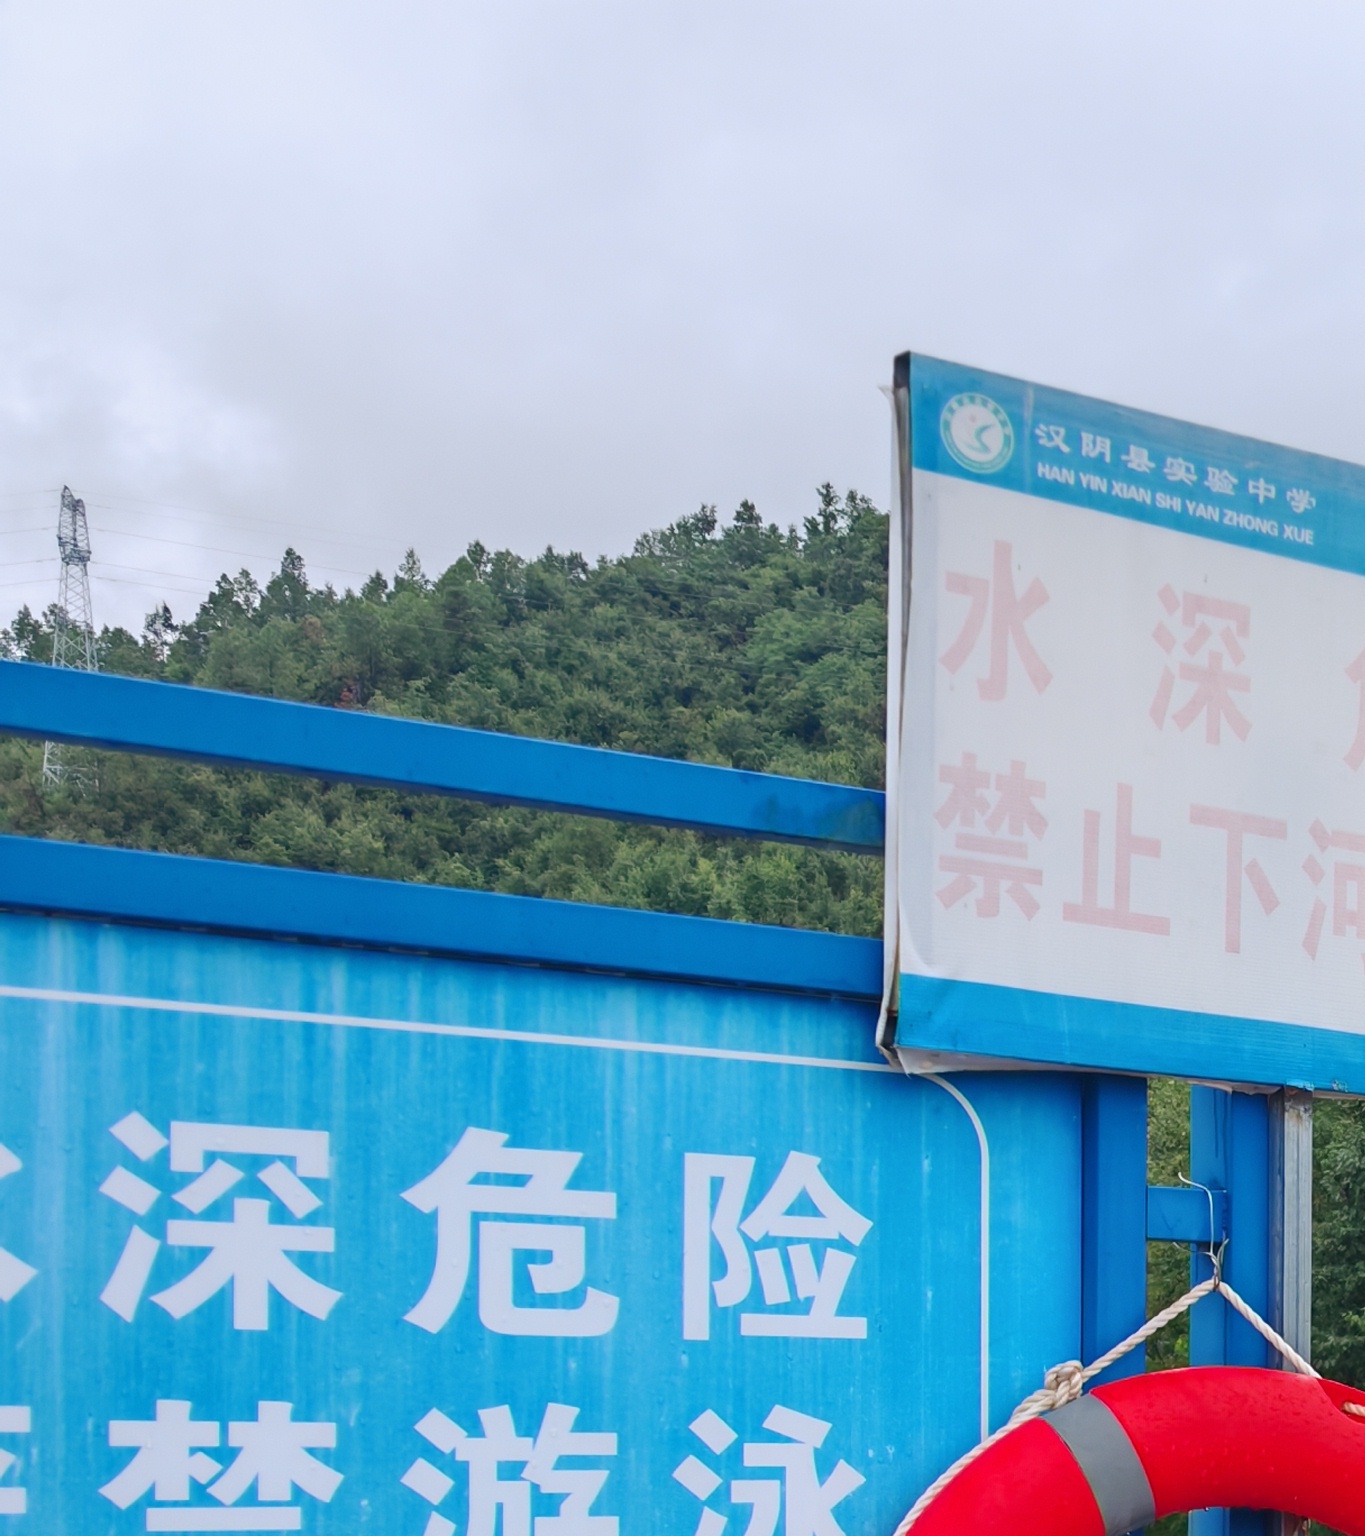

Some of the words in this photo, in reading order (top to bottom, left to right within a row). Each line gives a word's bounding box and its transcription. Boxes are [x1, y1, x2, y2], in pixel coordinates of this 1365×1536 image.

[1034, 423, 1316, 514] 汉阴县实验中学
[1037, 461, 1075, 485] HAN
[1079, 472, 1107, 493] YIN
[1111, 480, 1151, 505] XIAN
[1155, 491, 1181, 512] SHI
[1186, 499, 1220, 523] YAN
[1223, 510, 1278, 537] ZHONG
[1283, 523, 1314, 546] XUE
[0, 1110, 874, 1341] 深危险
